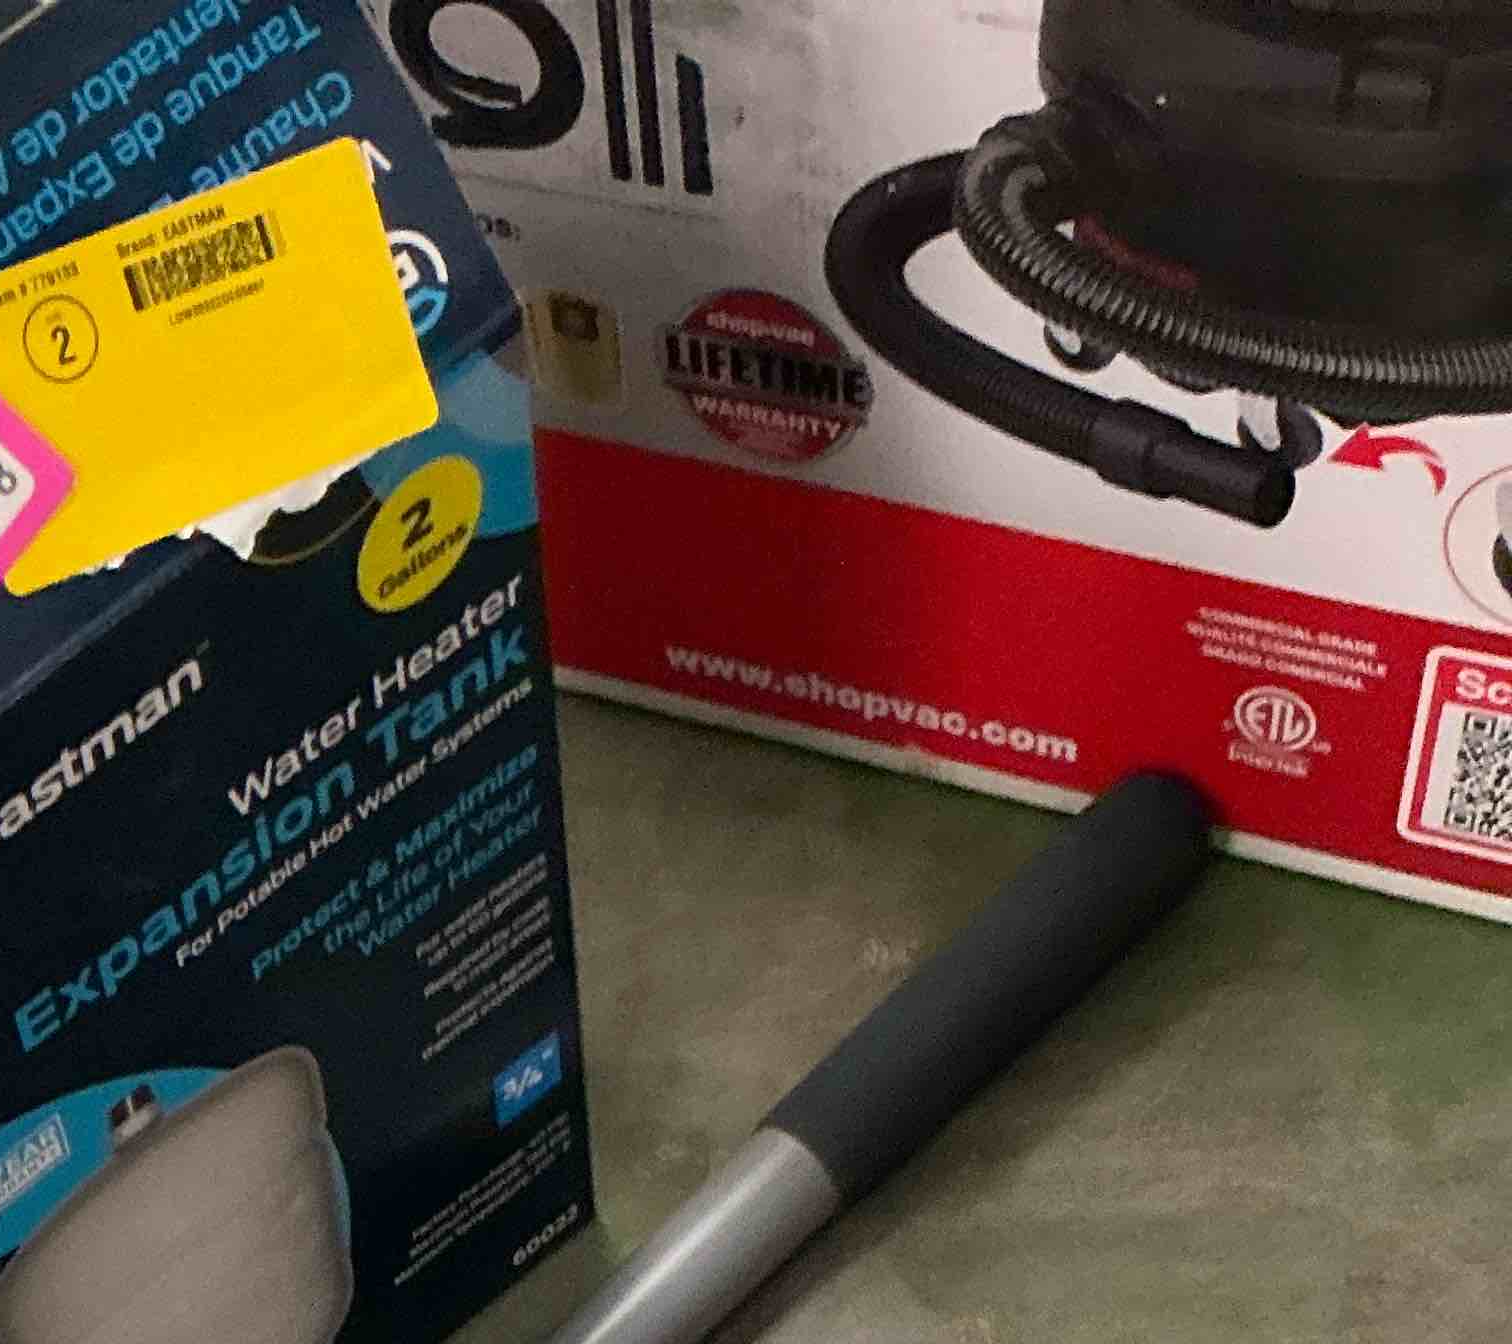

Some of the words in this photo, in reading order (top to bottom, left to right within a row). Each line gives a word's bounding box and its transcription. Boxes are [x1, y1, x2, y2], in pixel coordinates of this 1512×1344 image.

[167, 9, 320, 125] Tanque
[10, 109, 68, 165] de
[111, 111, 166, 166] de
[164, 205, 226, 242] EASTMAN
[51, 327, 76, 368] 2
[666, 333, 866, 401] LIFETIME
[693, 398, 846, 440] WARRANTY
[401, 497, 433, 552] 2
[226, 697, 361, 816] Water
[372, 574, 524, 709] Heater
[664, 644, 1079, 764] www.shopvac.com
[14, 762, 356, 1053] Expansion
[366, 626, 528, 768] Tank
[176, 928, 214, 968] For
[217, 850, 307, 934] Potable
[309, 813, 354, 860] Hot
[356, 755, 428, 820] Water
[431, 675, 533, 765] Systems
[251, 877, 360, 979] Protect
